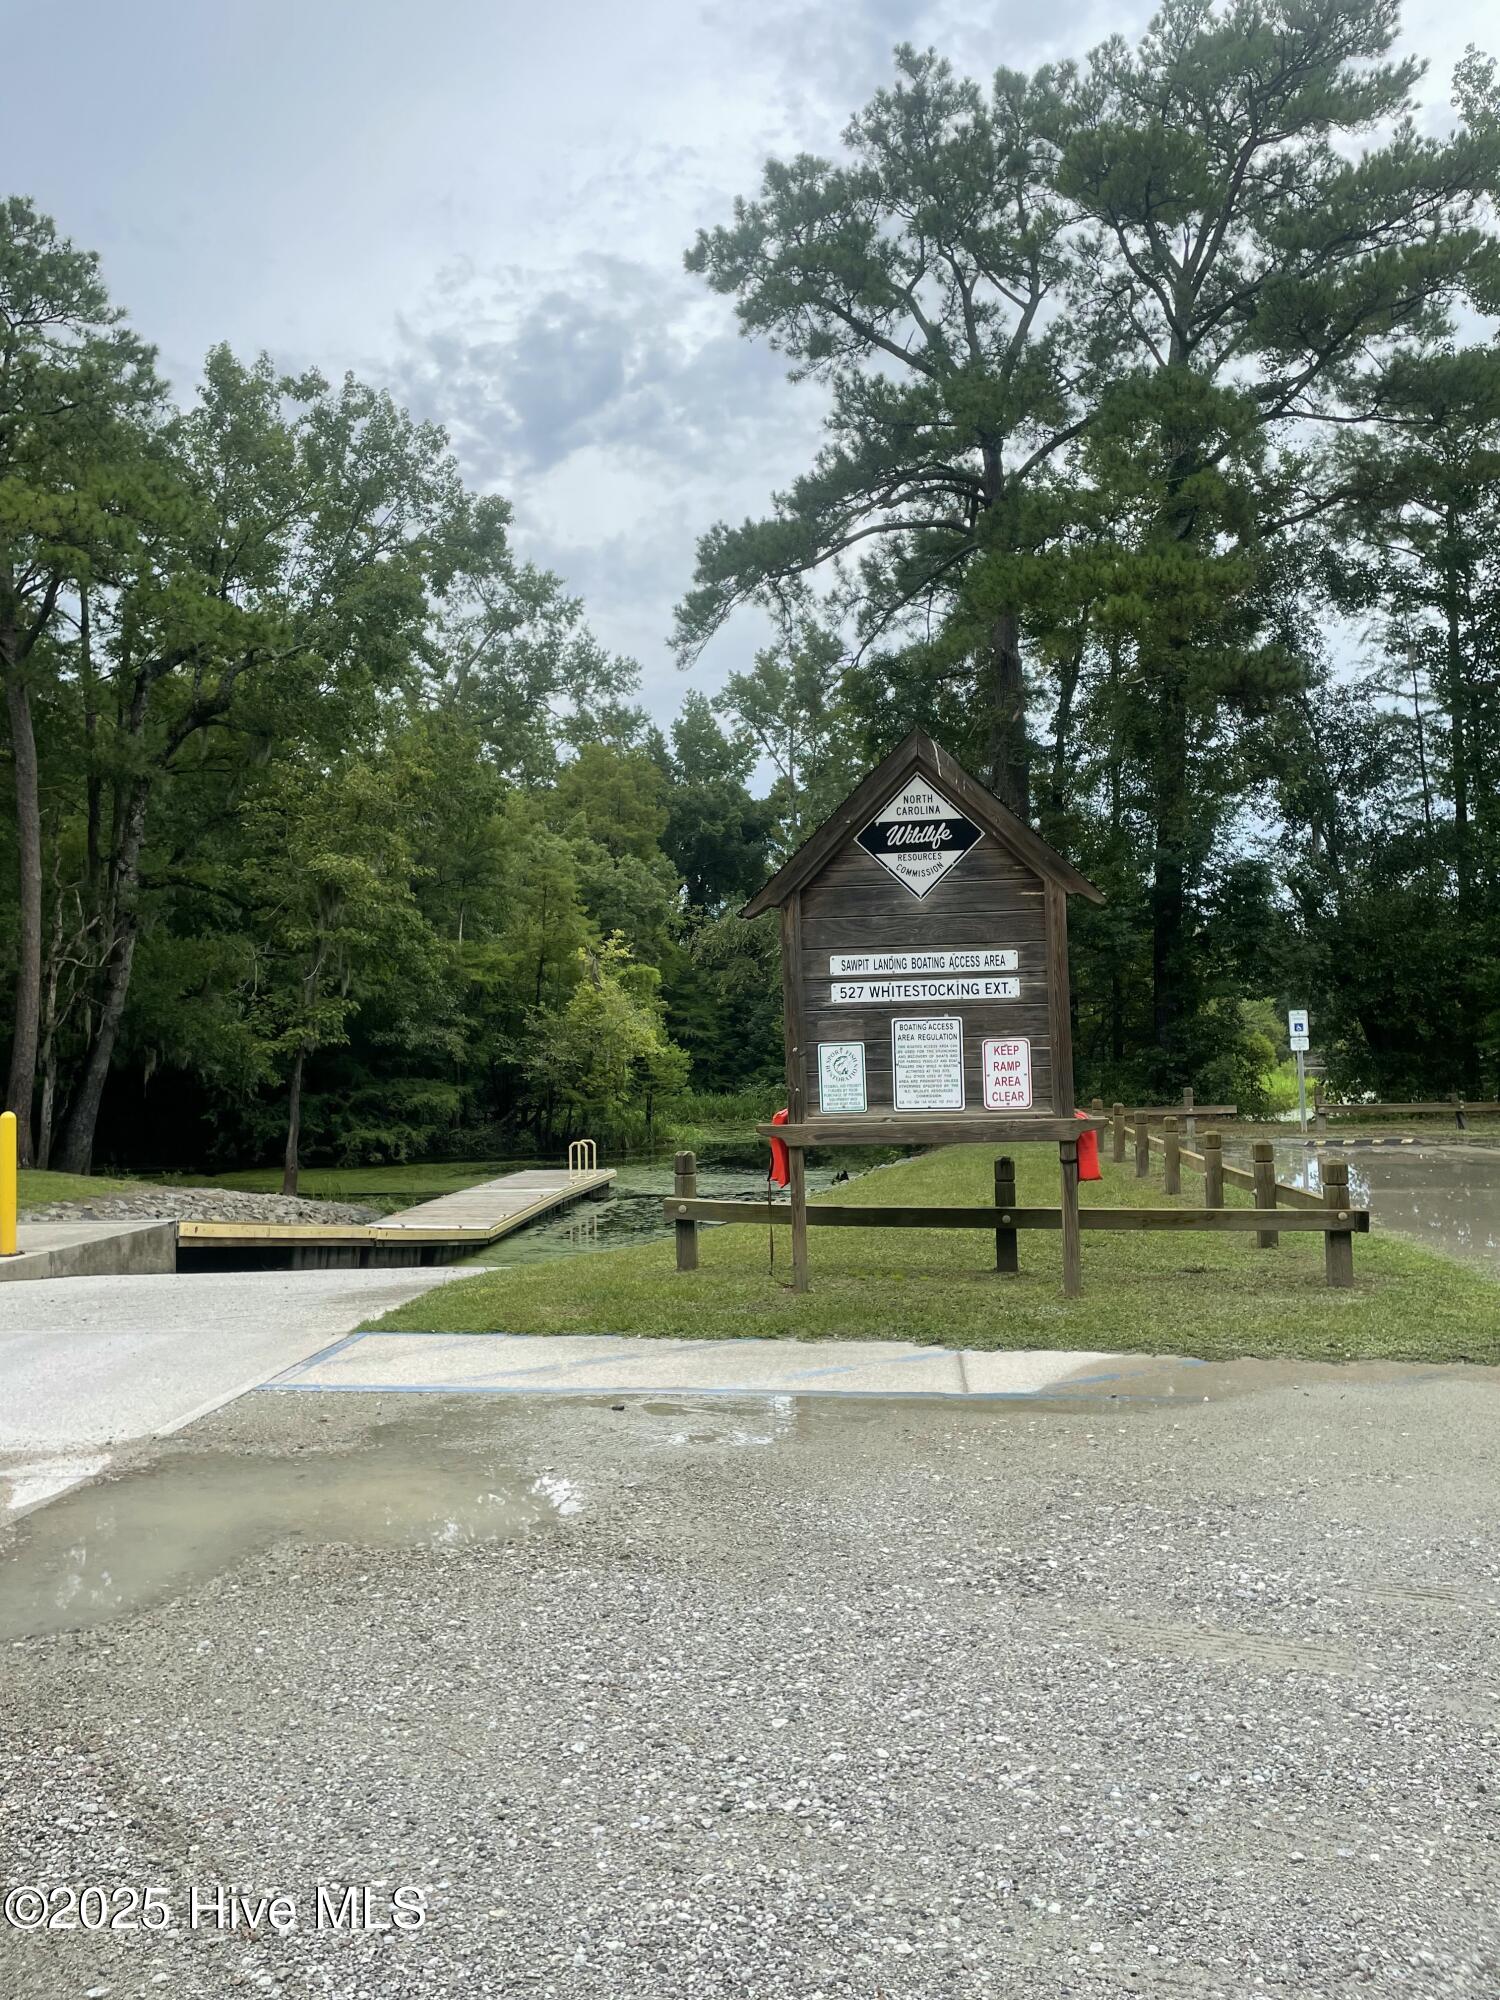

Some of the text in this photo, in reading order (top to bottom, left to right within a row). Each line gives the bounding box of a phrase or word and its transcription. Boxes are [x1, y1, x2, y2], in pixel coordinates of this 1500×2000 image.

[903, 794, 933, 804] NORTH
[896, 806, 941, 816] CAROLINA
[886, 822, 953, 849] Wildlife
[897, 852, 942, 862] RESOURCES
[896, 861, 945, 878] COMMISSION
[841, 953, 1006, 972] SAWPIT LANDING BOATING ACCESS AREA
[839, 981, 1012, 999] 527 WHITESTOCKING EXT.
[900, 1023, 927, 1031] BOATING
[993, 1045, 1020, 1056] KEEP
[993, 1061, 1021, 1072] RAMP
[994, 1076, 1021, 1087] AREA
[992, 1091, 1025, 1102] CLEAR
